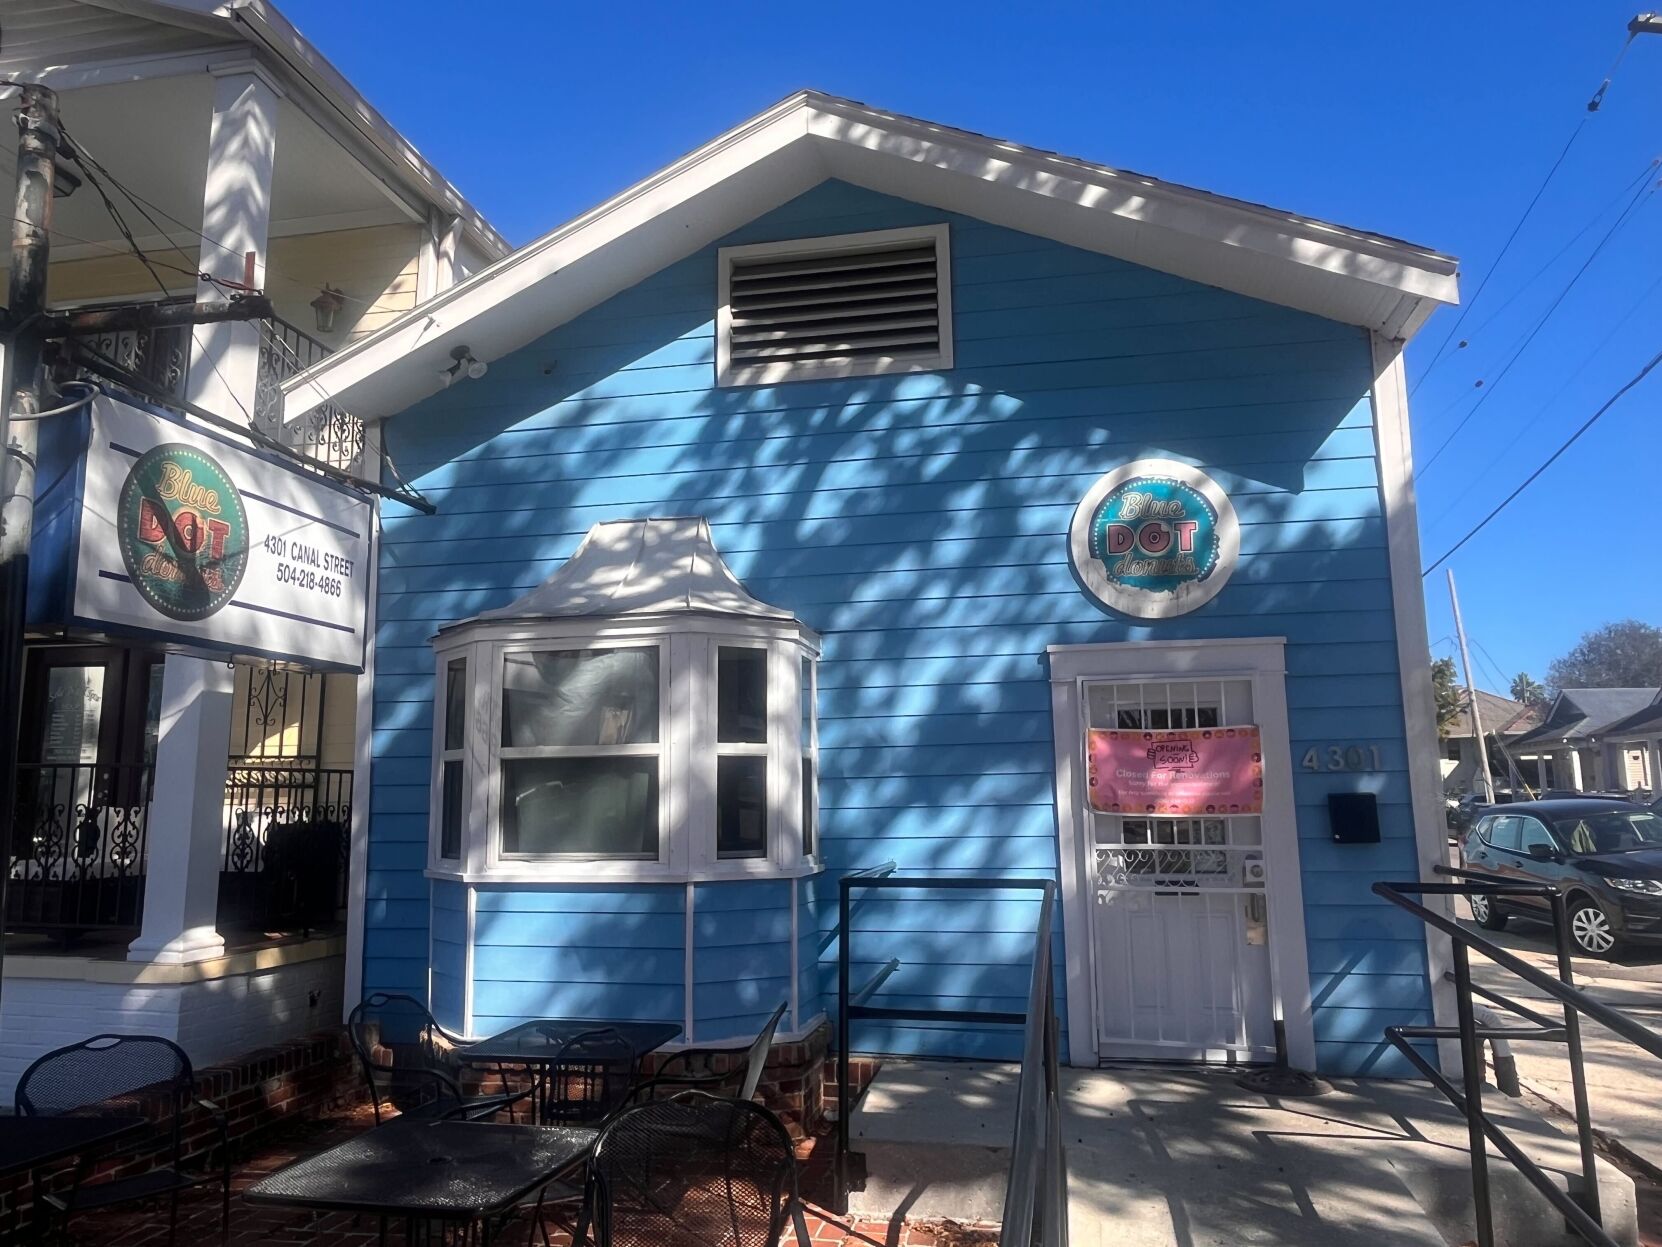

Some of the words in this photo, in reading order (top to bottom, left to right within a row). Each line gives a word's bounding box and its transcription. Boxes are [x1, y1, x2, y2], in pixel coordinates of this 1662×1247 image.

[156, 462, 221, 513] Blue
[1120, 492, 1185, 520] Blue
[138, 496, 230, 560] DOT
[1107, 521, 1198, 556] DOT
[141, 545, 226, 593] donts
[264, 534, 287, 558] 4301
[291, 542, 321, 570] CANAL
[323, 552, 354, 579] STREET
[1113, 553, 1199, 577] donuts
[276, 563, 342, 598] 504-218-4866
[1156, 743, 1190, 753] OPENING
[1302, 744, 1381, 771] 4301
[1116, 768, 1149, 779] Closed
[1151, 771, 1167, 779] For
